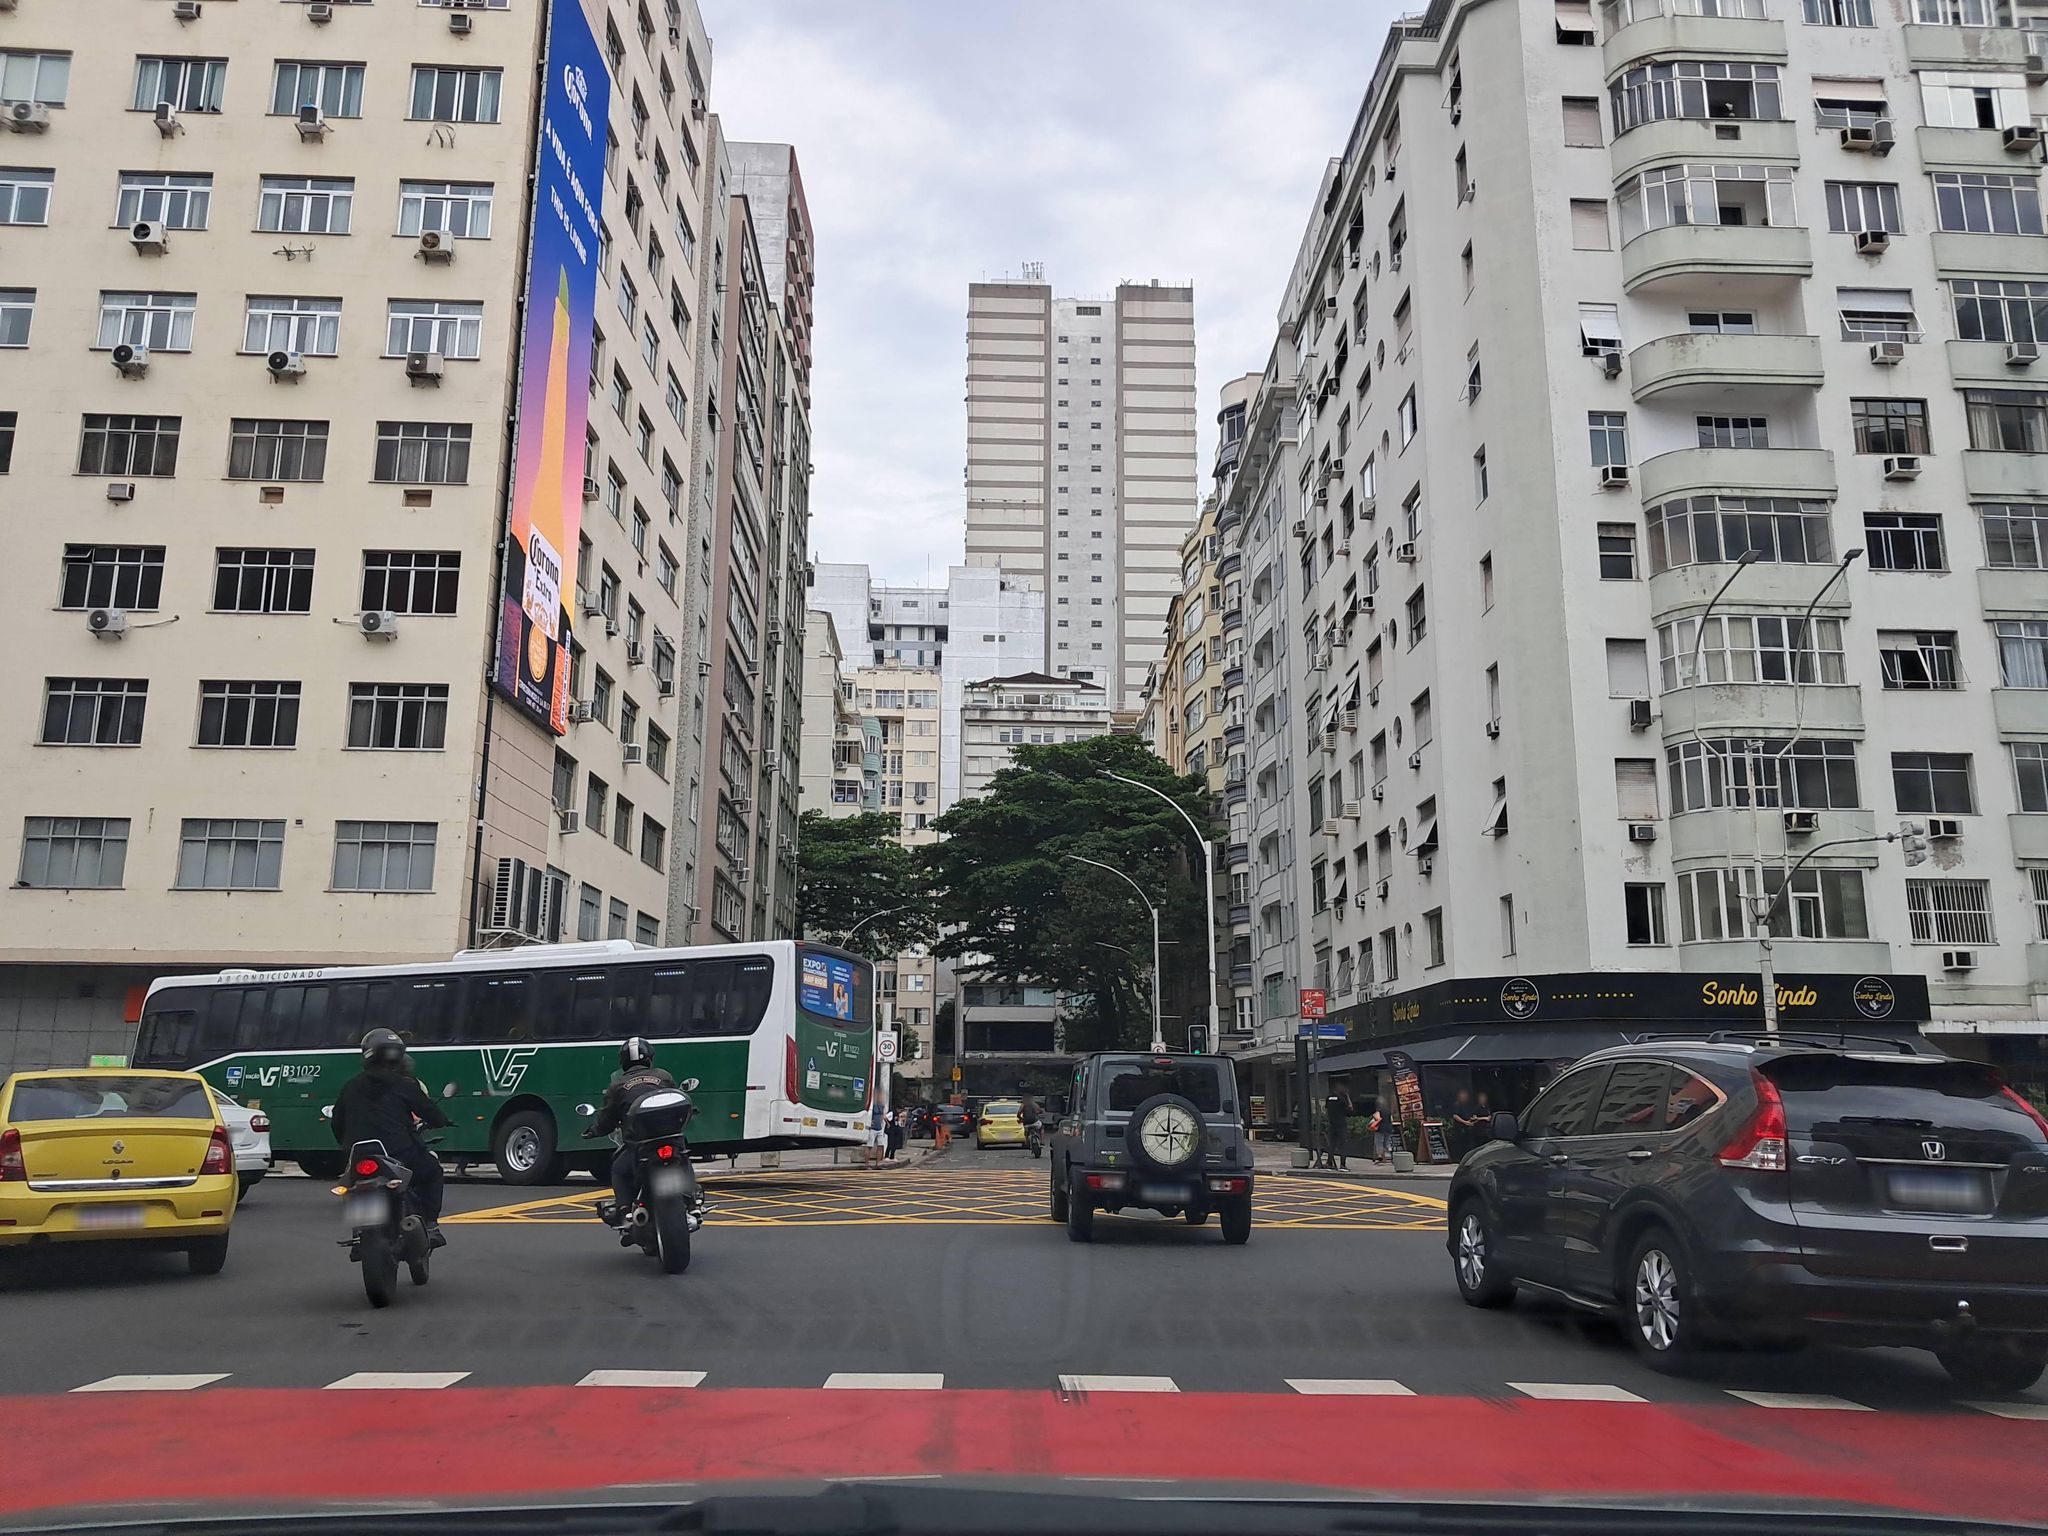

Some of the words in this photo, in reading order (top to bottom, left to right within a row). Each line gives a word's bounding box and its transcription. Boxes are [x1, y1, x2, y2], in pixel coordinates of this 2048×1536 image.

[564, 65, 592, 143] Corona
[546, 118, 551, 139] A
[552, 128, 566, 170] VIDA
[566, 156, 571, 180] É
[571, 170, 585, 208] AQUI
[584, 198, 598, 238] FORA
[551, 185, 564, 220] THIS
[563, 211, 570, 233] IS
[569, 222, 587, 266] LIVING
[530, 534, 559, 594] Corona
[535, 569, 552, 604] Extra
[217, 975, 231, 983] AR
[236, 970, 323, 982] CONDICIONADO
[803, 958, 821, 970] EXPO
[1702, 981, 1757, 1006] Sonho
[1774, 983, 1817, 1011] indo
[1855, 991, 1874, 1000] Sonho
[825, 1040, 838, 1057] VG
[259, 1066, 280, 1087] VG
[282, 1065, 321, 1078] B31022
[480, 1047, 539, 1095] VG
